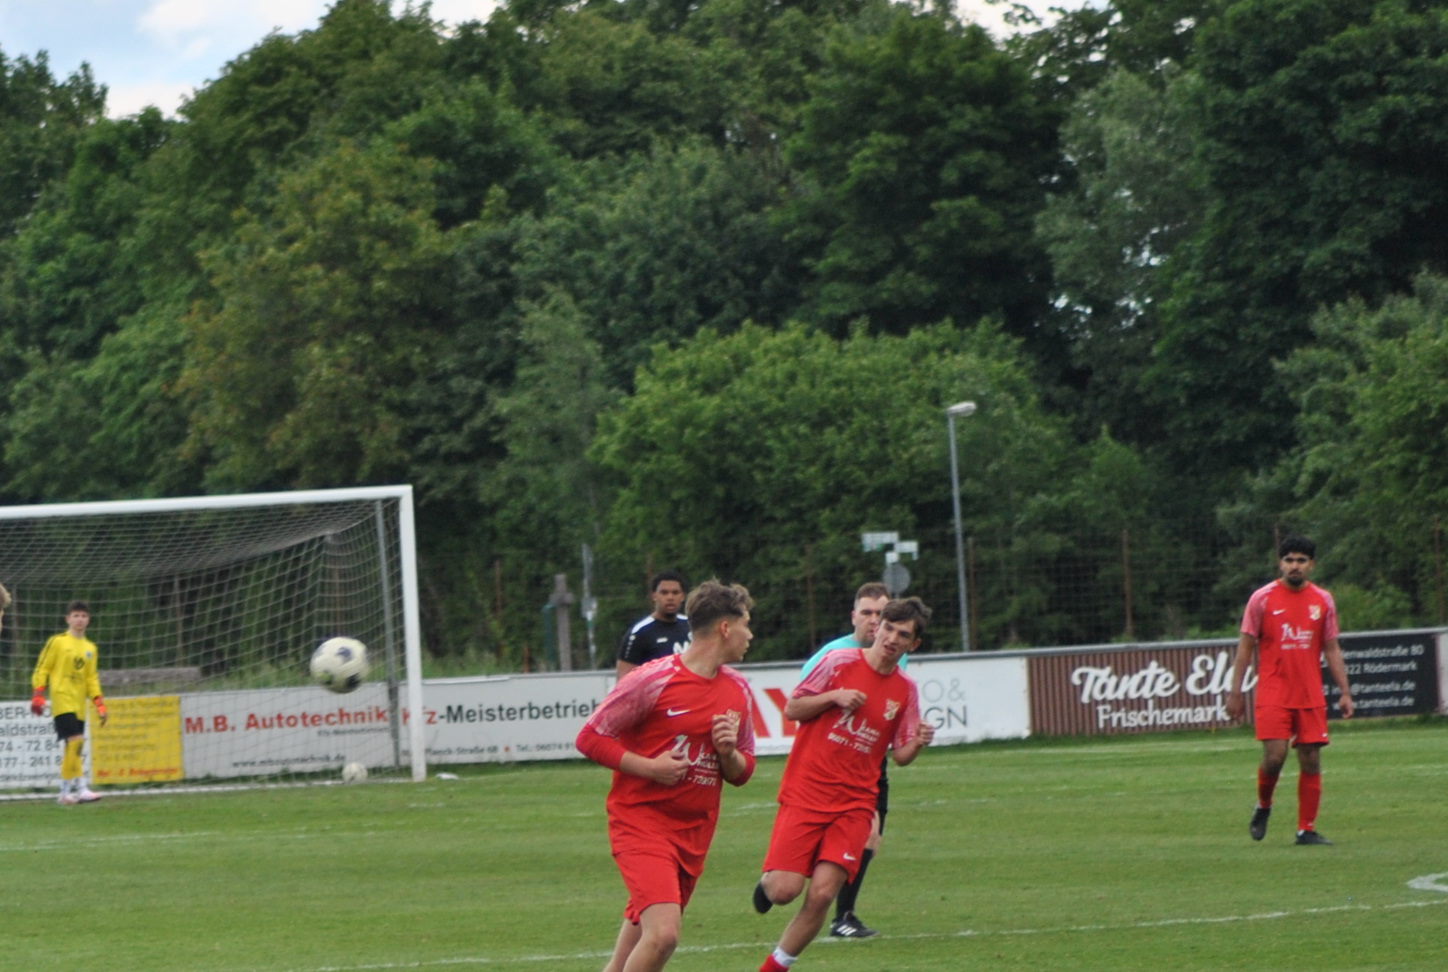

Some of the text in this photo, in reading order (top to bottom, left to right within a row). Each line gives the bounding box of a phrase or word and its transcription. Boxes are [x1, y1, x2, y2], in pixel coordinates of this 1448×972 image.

[1071, 660, 1181, 704] Tante
[1363, 660, 1418, 674] Rödermark
[184, 715, 236, 734] M.B.
[245, 705, 390, 730] Autotechnik
[1097, 694, 1232, 729] Frischemark
